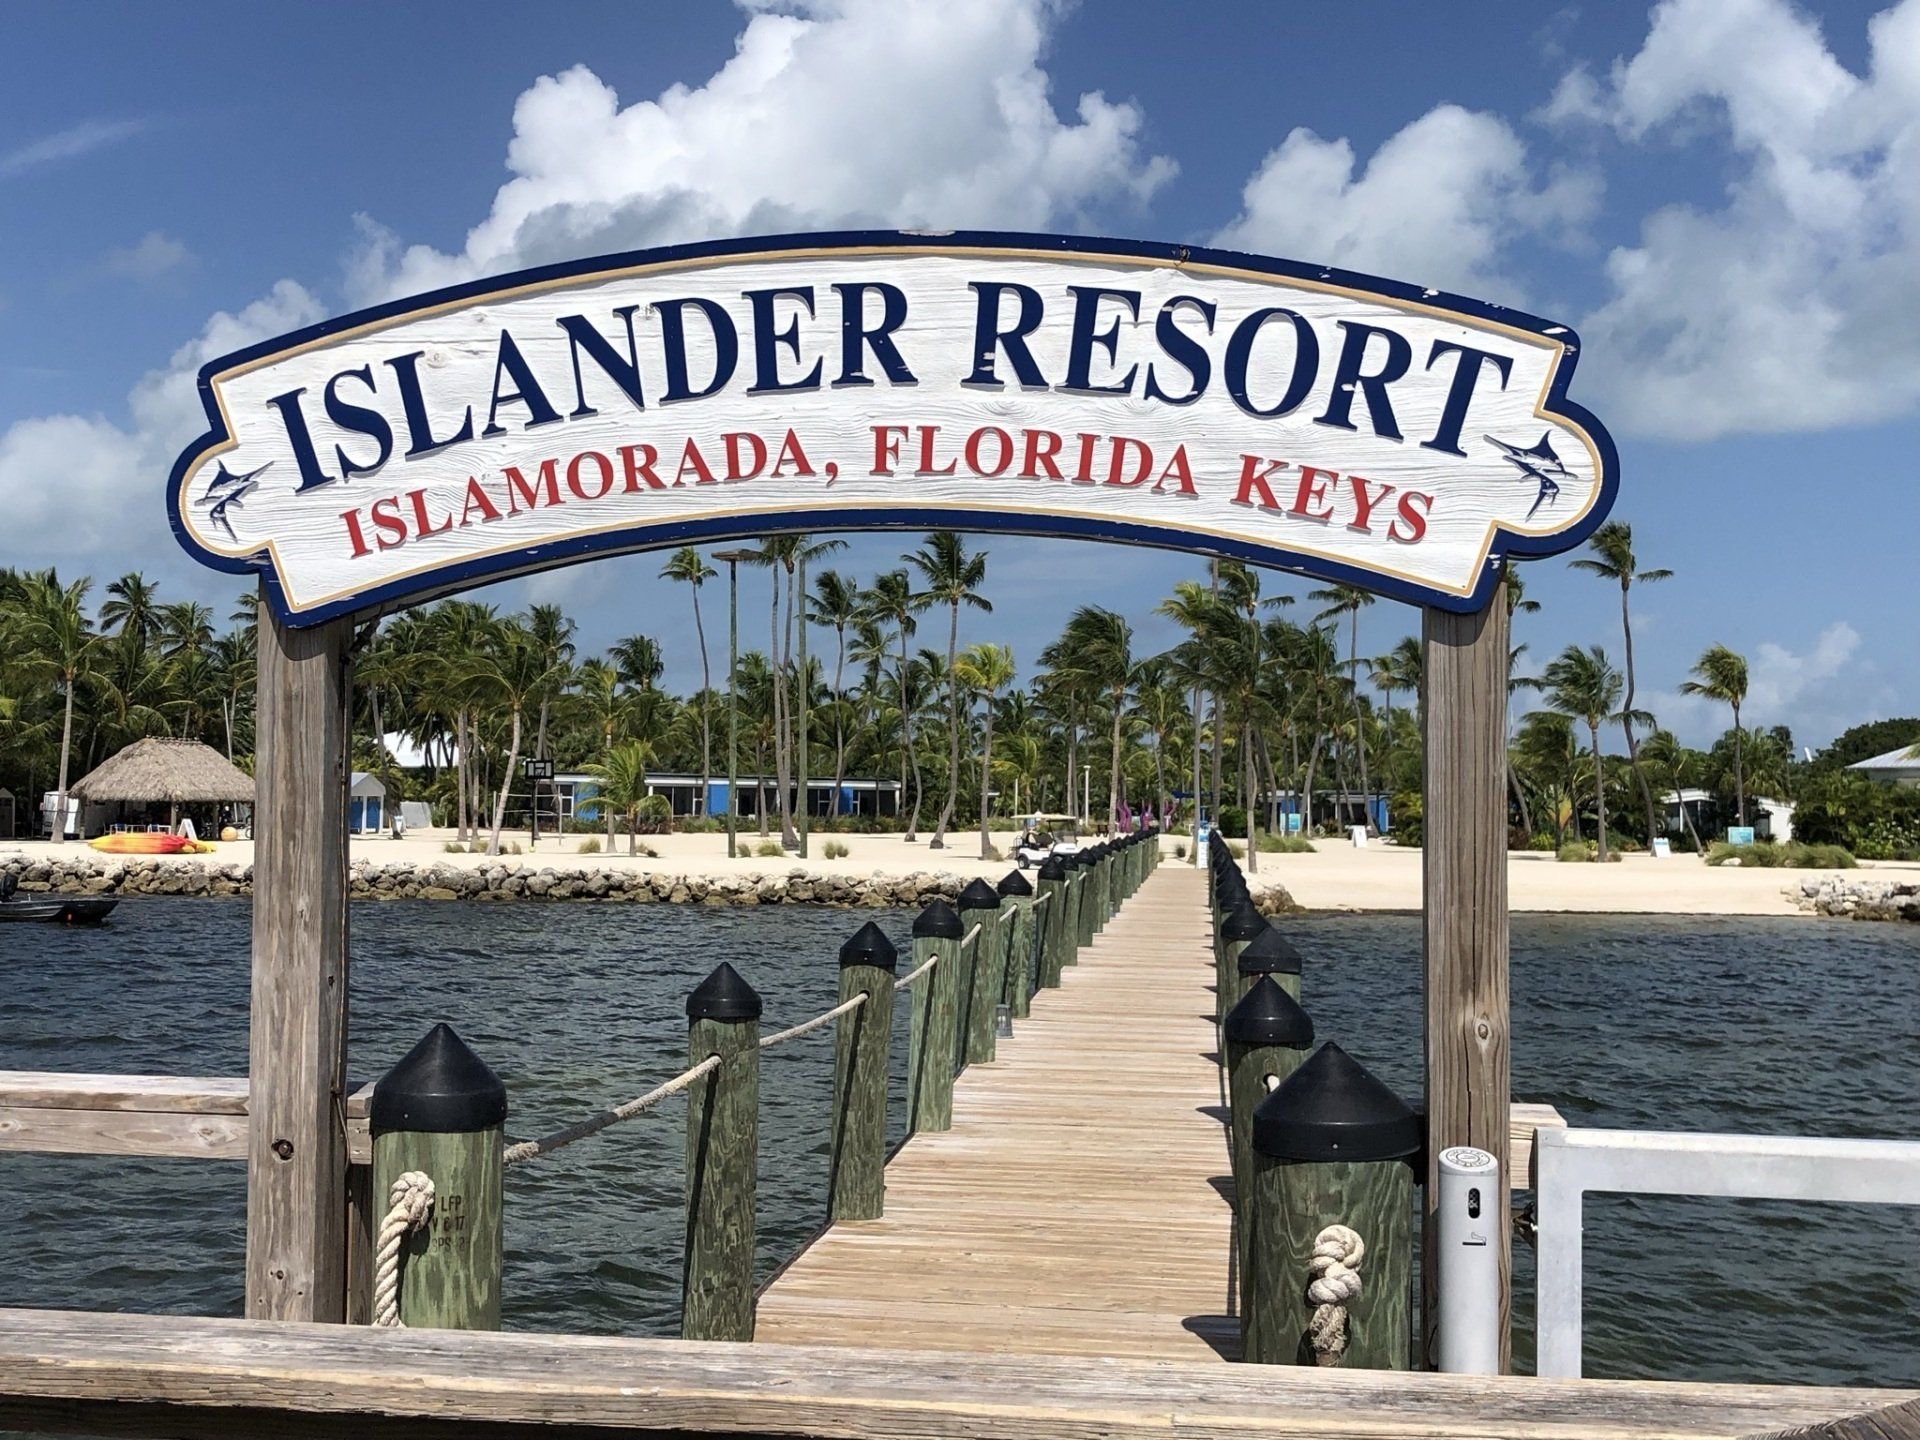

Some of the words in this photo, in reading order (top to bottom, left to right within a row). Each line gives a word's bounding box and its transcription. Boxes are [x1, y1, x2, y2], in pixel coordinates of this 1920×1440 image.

[267, 282, 918, 493] ISLANDER
[961, 282, 1514, 458] RESORT
[339, 427, 839, 559] ISLAMORADA,
[870, 426, 1199, 498] FLORIDA
[1230, 454, 1435, 544] KEYS
[441, 1195, 462, 1212] LFP
